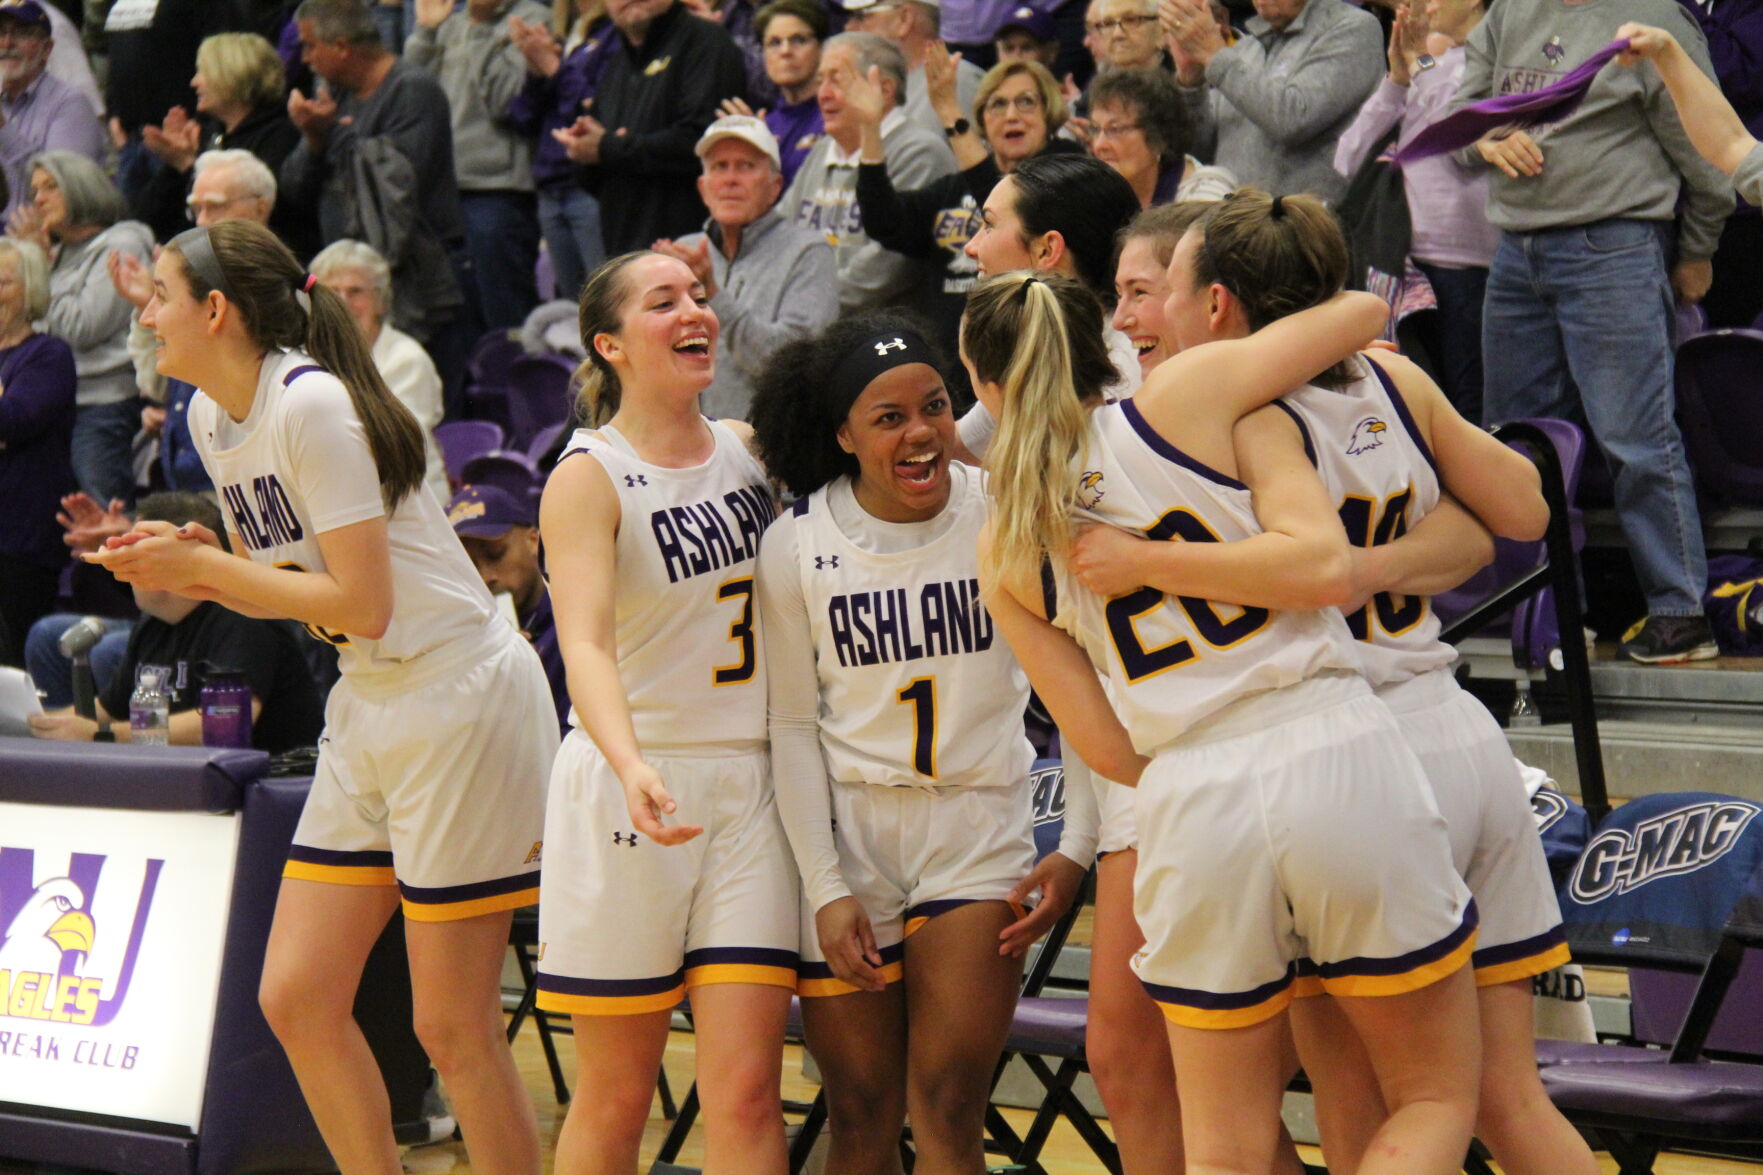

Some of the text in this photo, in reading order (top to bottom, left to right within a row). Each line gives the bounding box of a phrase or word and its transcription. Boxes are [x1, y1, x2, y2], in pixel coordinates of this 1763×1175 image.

[712, 576, 758, 687] 3
[828, 578, 993, 667] ASHLAND
[896, 675, 939, 779] 1
[1569, 801, 1762, 905] G-MAC
